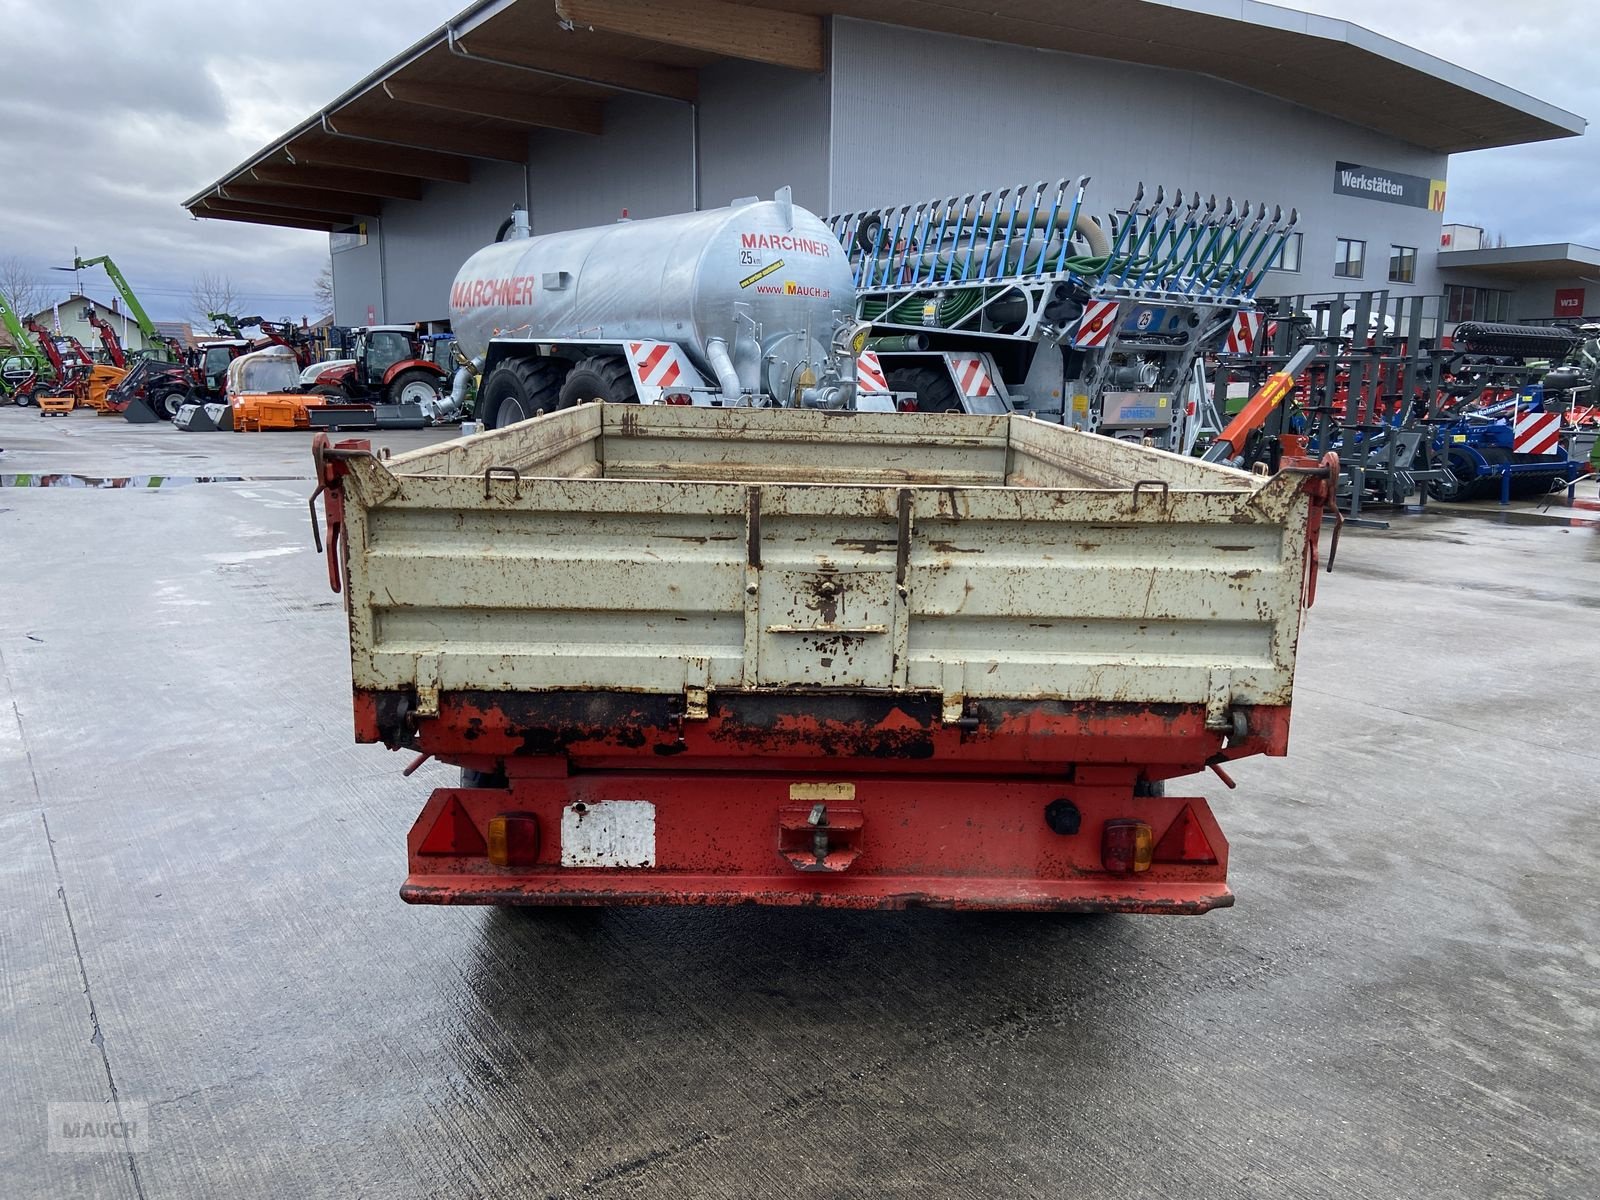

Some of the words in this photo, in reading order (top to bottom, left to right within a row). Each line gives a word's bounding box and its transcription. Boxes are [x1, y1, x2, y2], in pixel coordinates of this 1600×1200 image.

[1341, 170, 1403, 196] Werkstätten
[741, 233, 830, 257] MARCHNER
[741, 250, 753, 264] 25
[452, 276, 535, 308] MARCHNER
[1560, 299, 1578, 307] W13
[1139, 313, 1151, 326] 25
